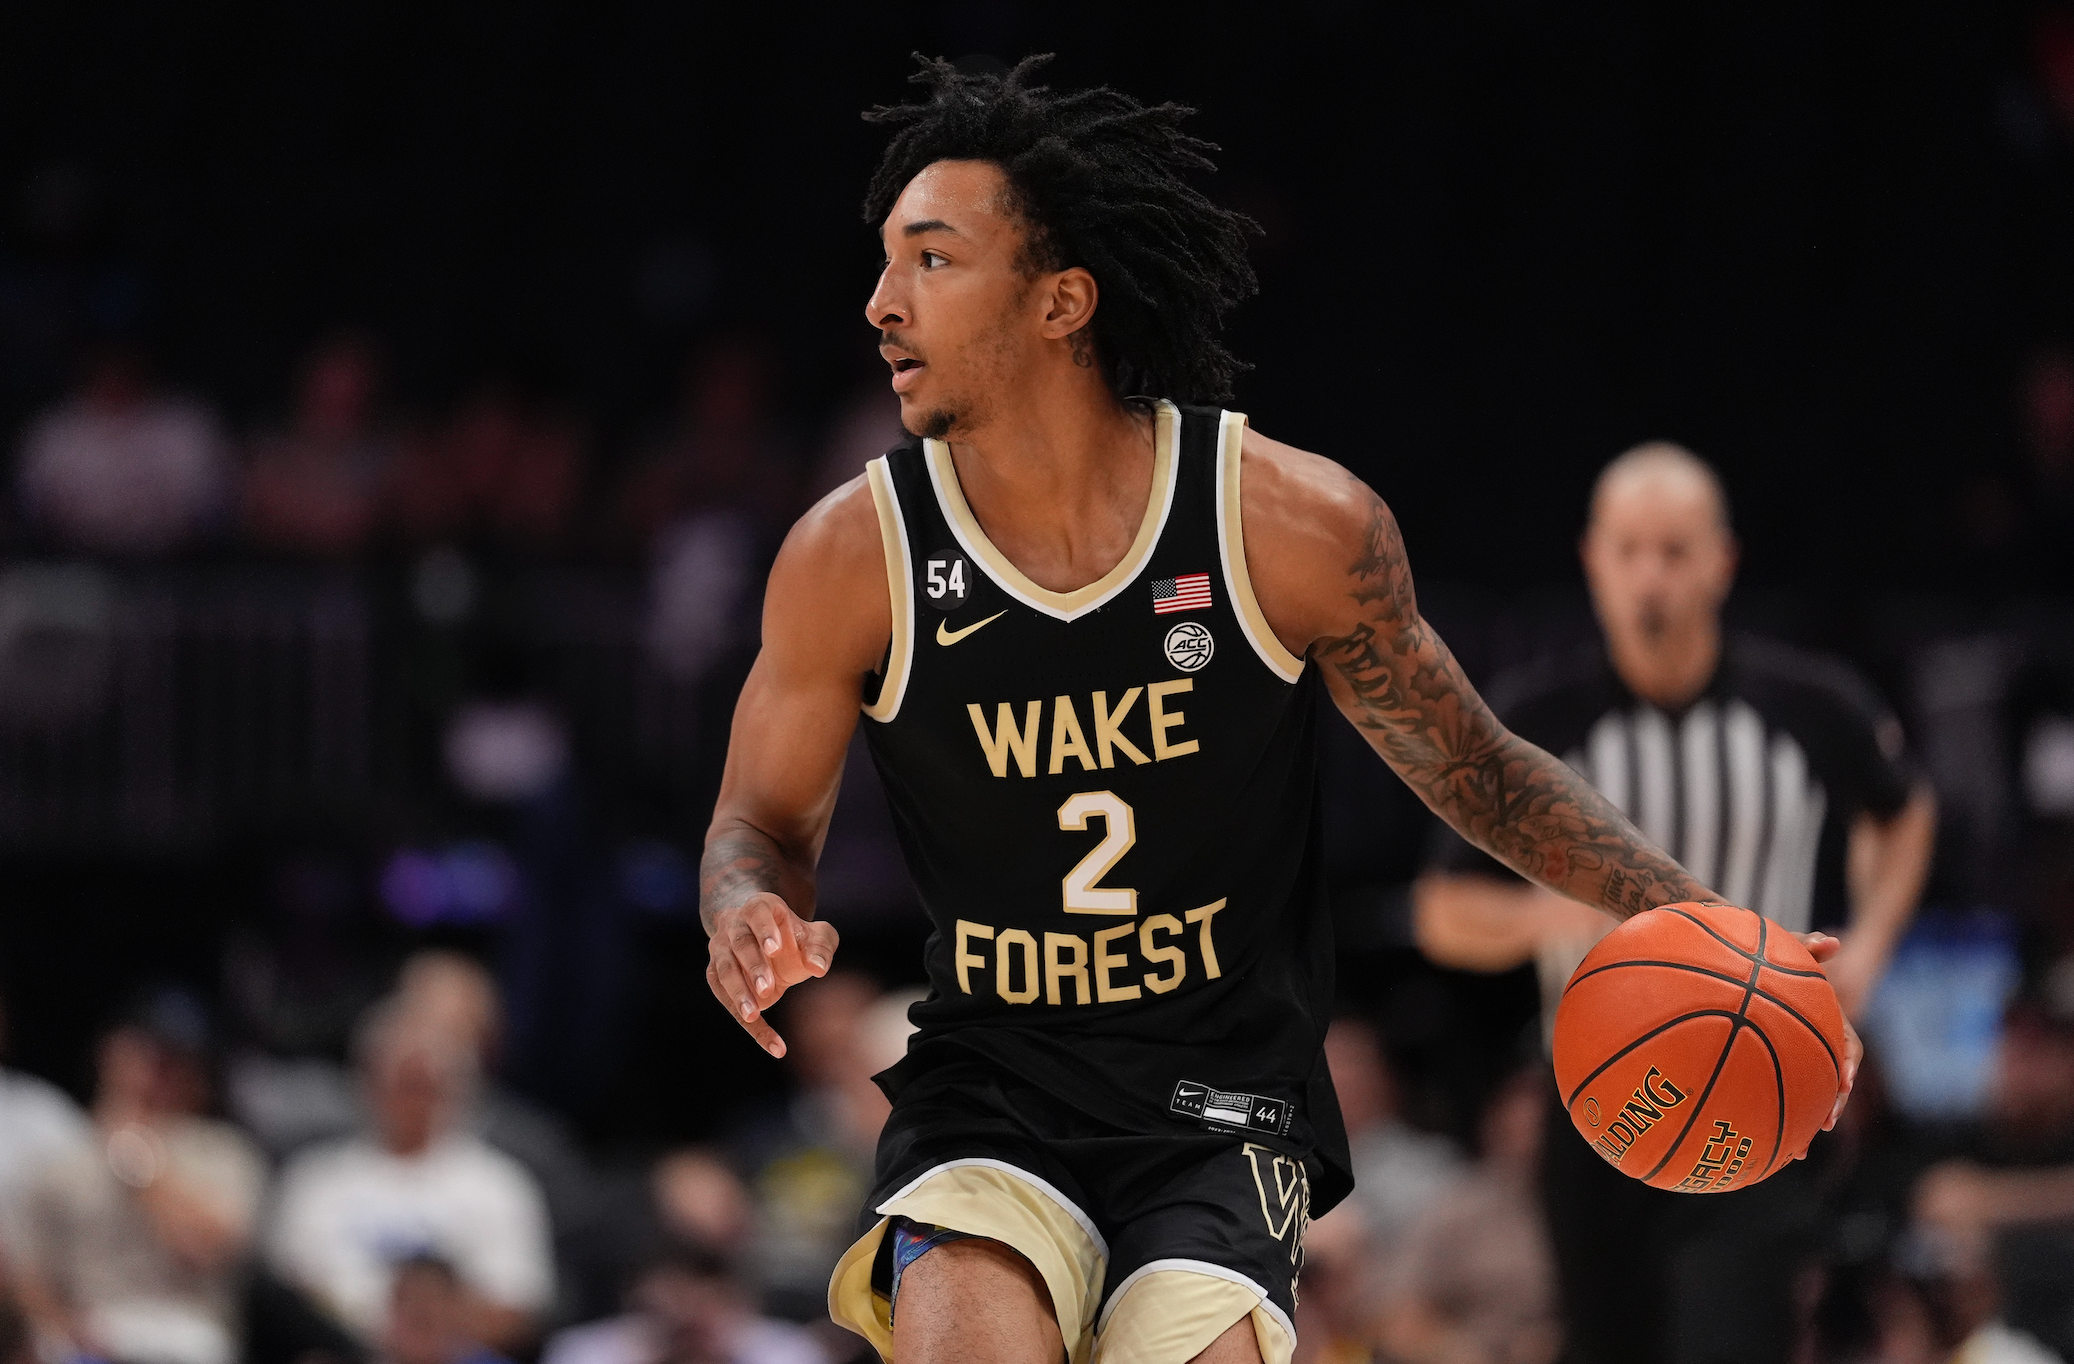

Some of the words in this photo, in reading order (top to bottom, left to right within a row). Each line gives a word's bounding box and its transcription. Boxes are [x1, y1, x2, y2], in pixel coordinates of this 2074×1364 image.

[926, 559, 966, 599] 54
[1173, 636, 1209, 650] ACC
[966, 677, 1200, 778] WAKE
[1057, 789, 1138, 916] 2
[955, 896, 1228, 1006] FOREST
[1176, 1098, 1201, 1110] TEAM
[1255, 1106, 1277, 1124] 44
